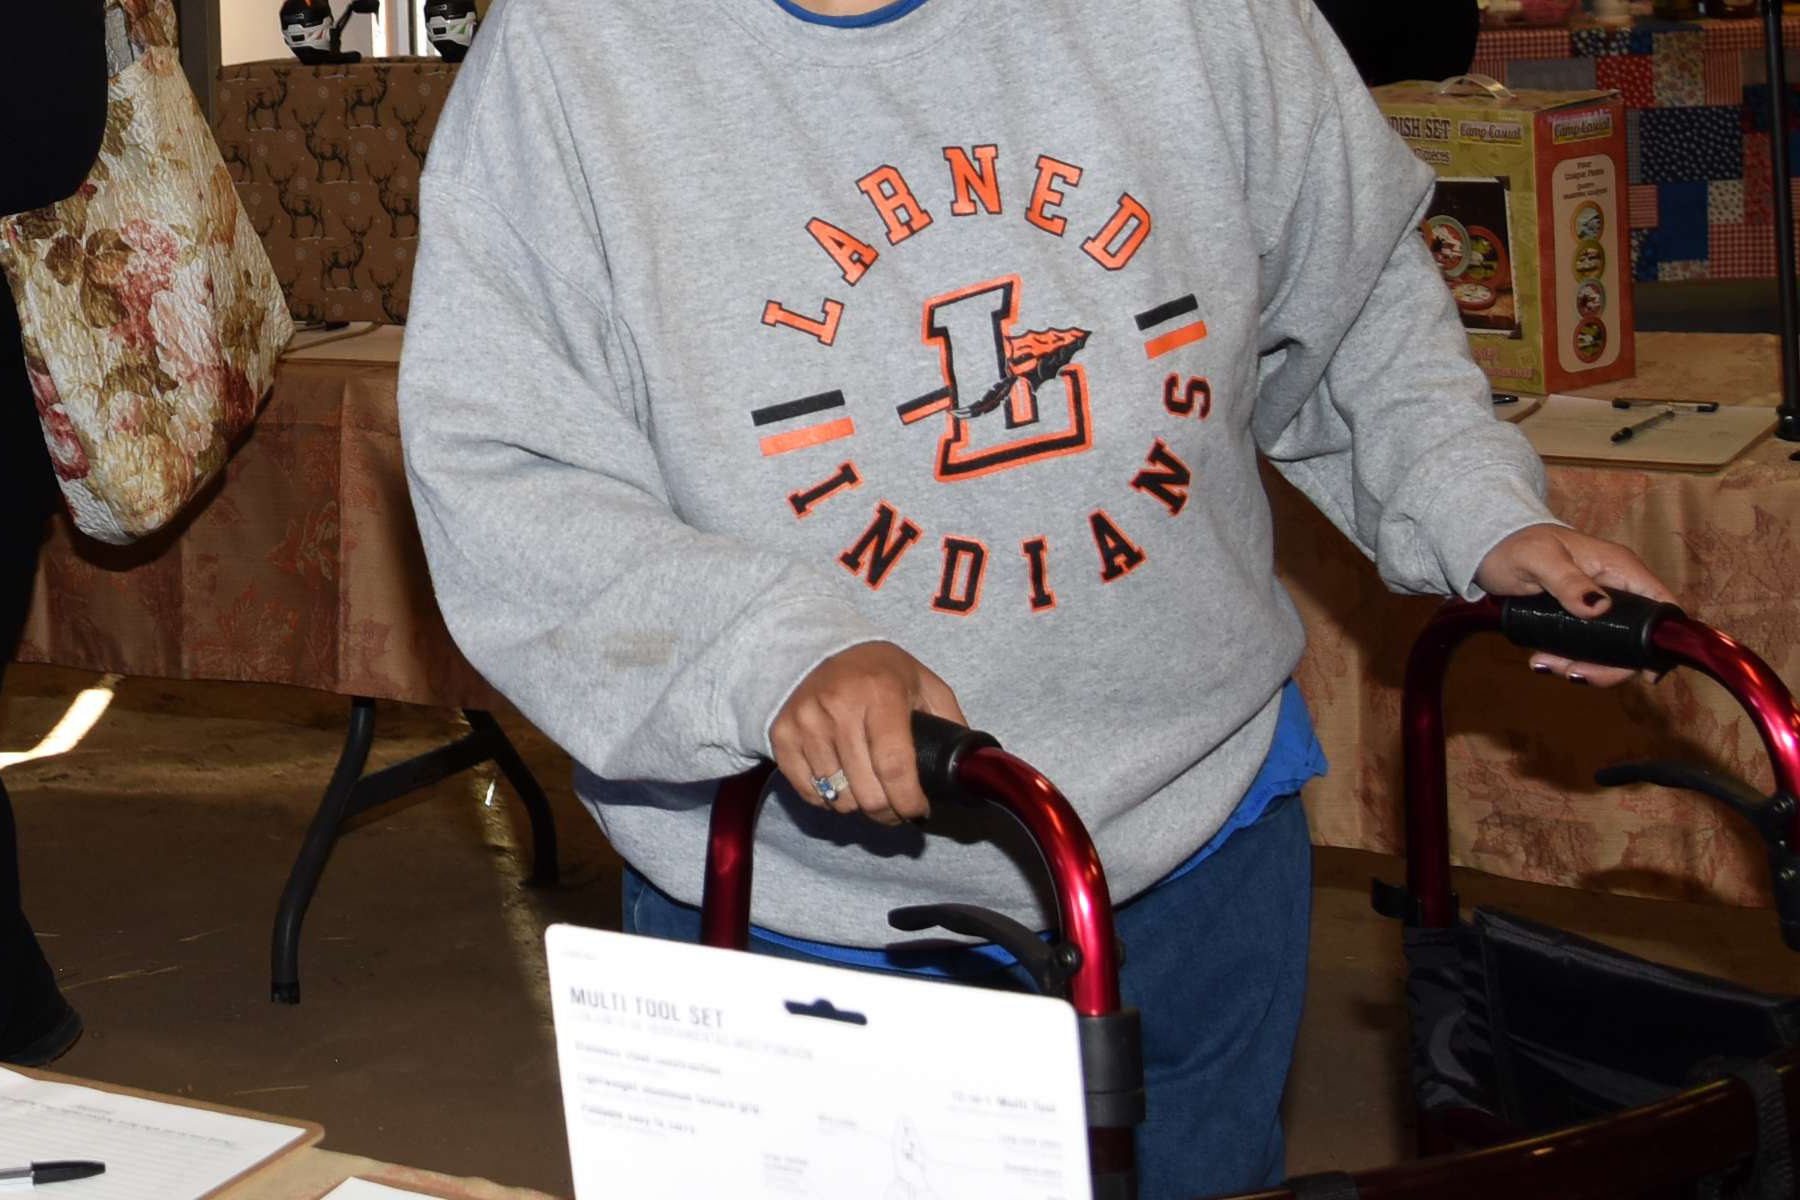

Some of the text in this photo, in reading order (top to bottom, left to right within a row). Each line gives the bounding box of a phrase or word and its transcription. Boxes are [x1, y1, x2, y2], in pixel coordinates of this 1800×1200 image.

[1425, 118, 1451, 139] SET
[761, 143, 1153, 346] LARNED
[787, 372, 1212, 616] INDIANS
[570, 986, 724, 1029] MULTI TOOL SET
